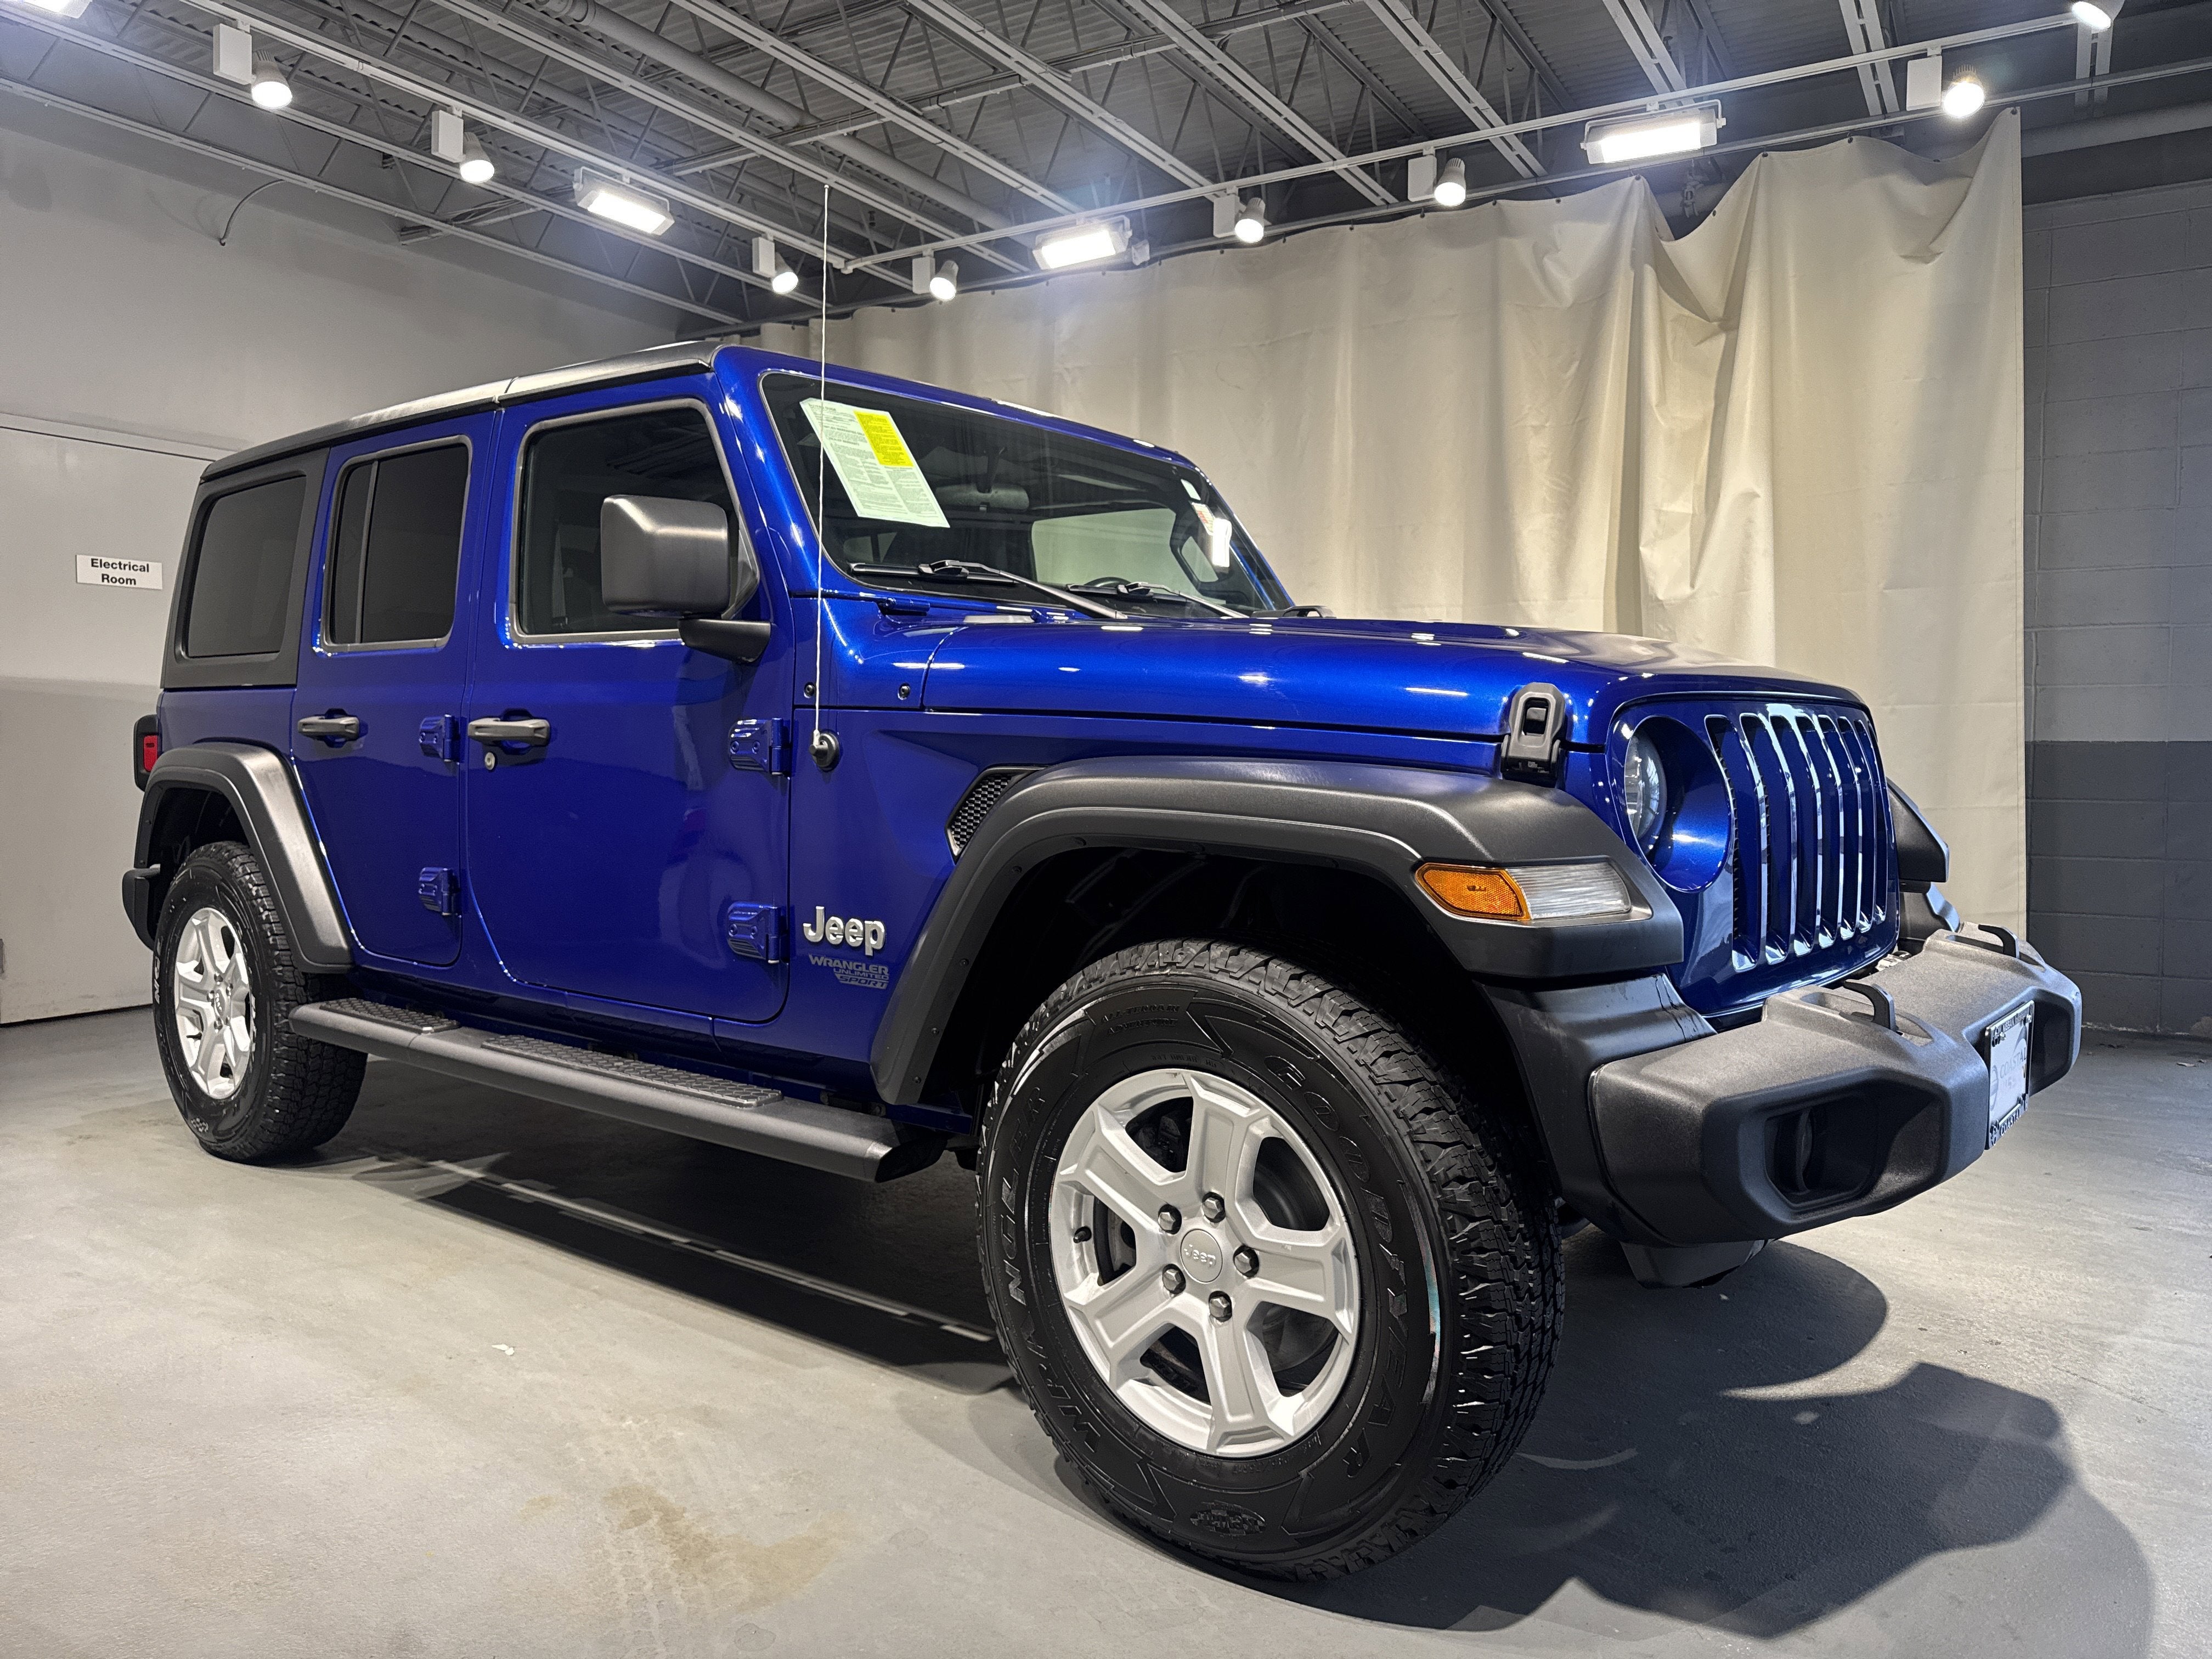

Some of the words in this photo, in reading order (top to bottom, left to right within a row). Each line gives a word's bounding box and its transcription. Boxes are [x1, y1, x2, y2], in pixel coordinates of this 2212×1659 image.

[91, 558, 149, 572] Electrical
[101, 573, 137, 585] Room
[803, 906, 885, 956] Jeep
[809, 954, 889, 975] WRANGLER
[833, 968, 889, 980] UNLIMITED
[838, 974, 888, 988] SPORT
[2000, 1047, 2027, 1079] COASTAL
[2000, 1108, 2022, 1136] COASTAL
[1183, 1244, 1216, 1267] Jeep
[1263, 1056, 1408, 1477] GOODYEAR
[1000, 1086, 1101, 1453] WRANGLER
